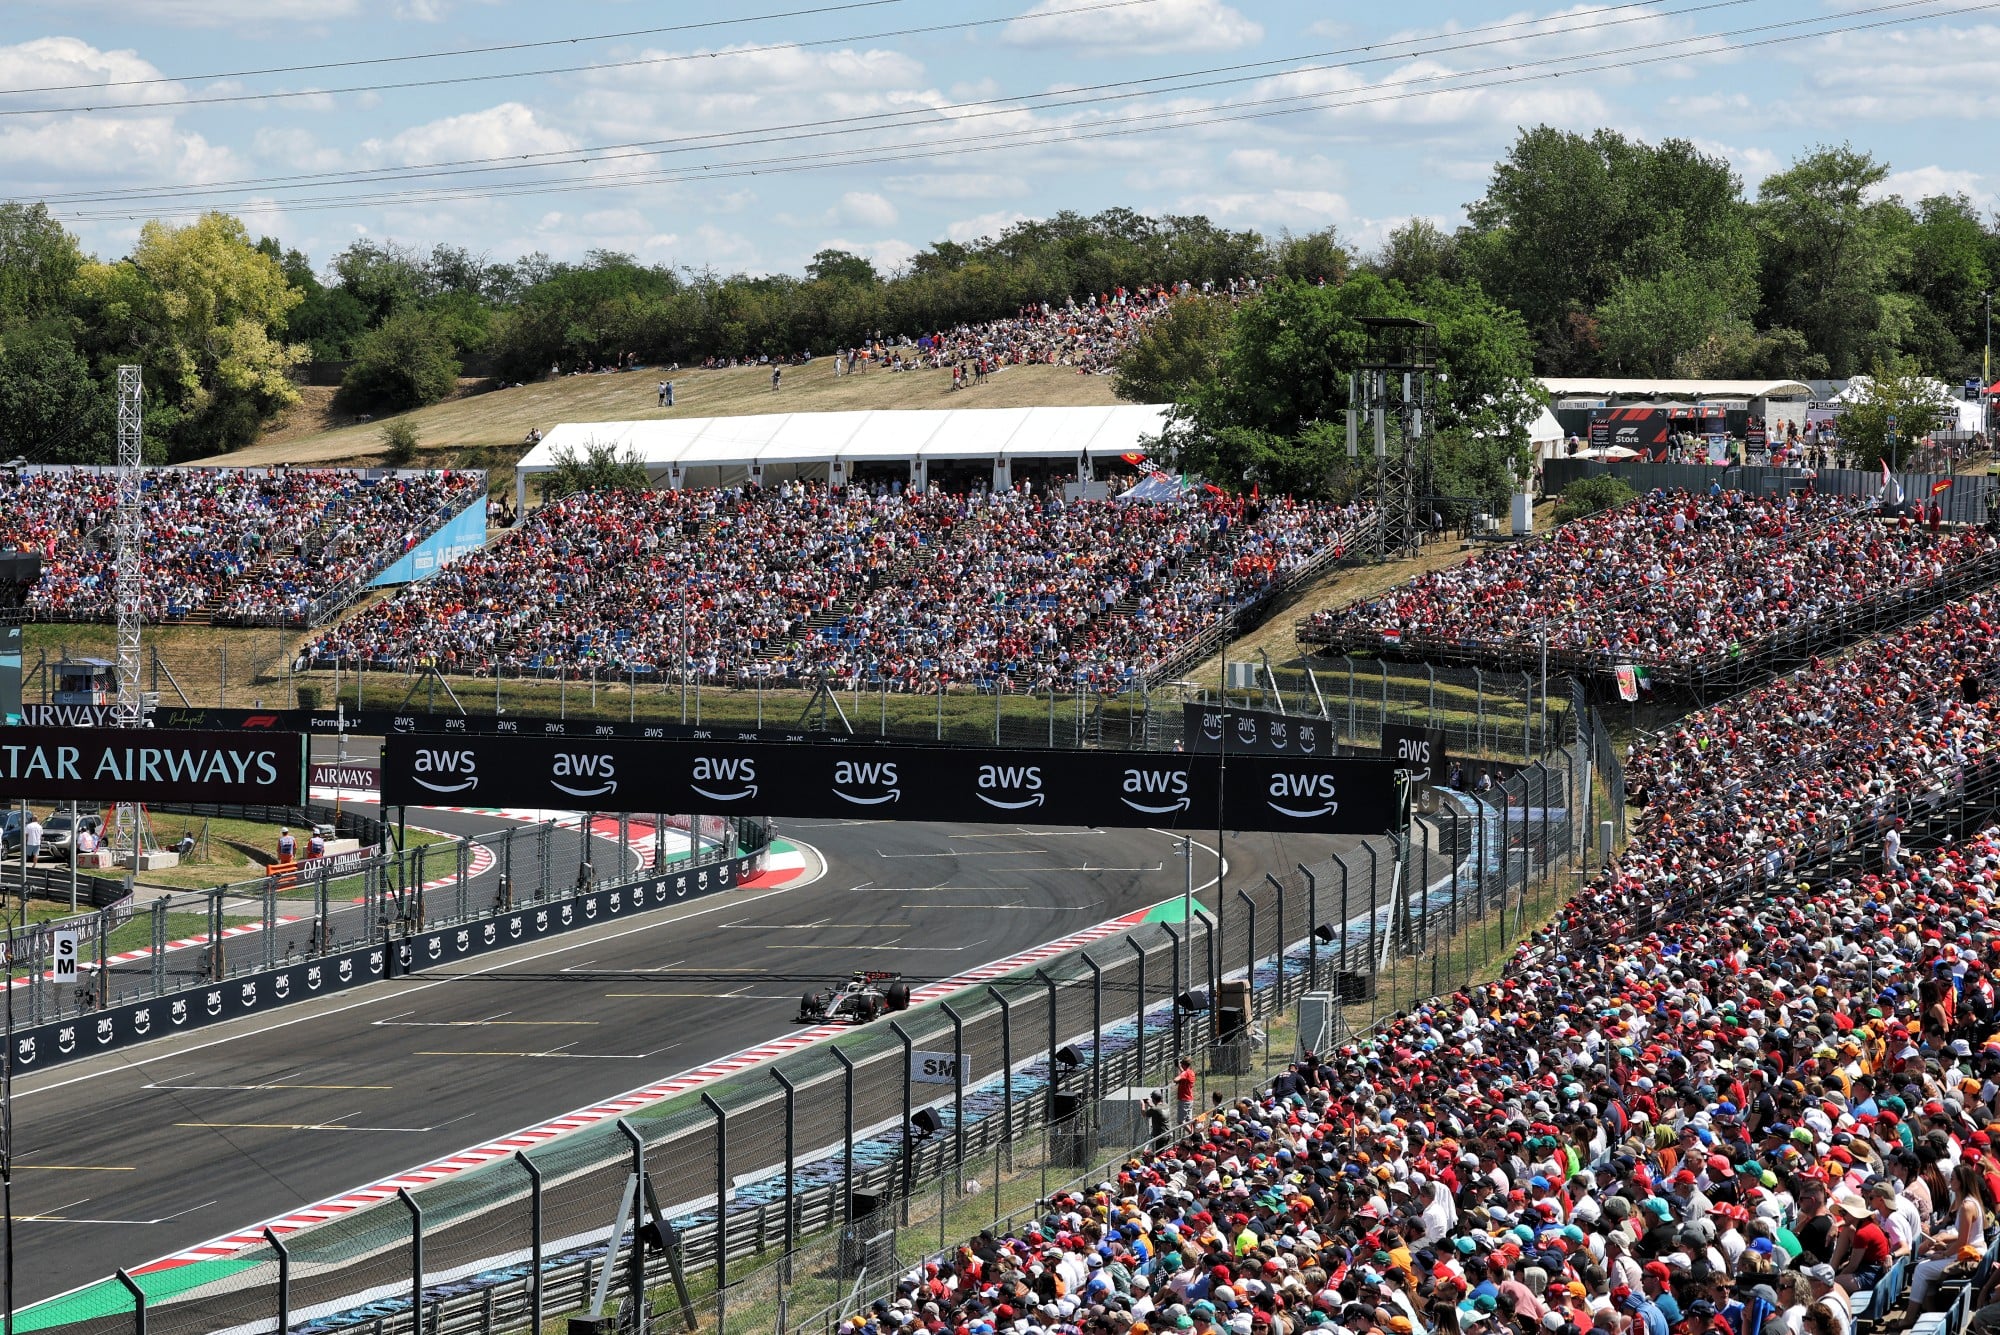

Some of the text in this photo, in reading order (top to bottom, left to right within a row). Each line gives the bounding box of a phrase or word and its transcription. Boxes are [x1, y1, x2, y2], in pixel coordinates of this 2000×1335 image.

[1615, 435, 1640, 443] Store
[394, 716, 415, 726] aws
[445, 718, 465, 728] aws
[497, 720, 517, 730] aws
[545, 722, 565, 732] aws
[1203, 713, 1222, 730] aws
[1238, 716, 1256, 733] aws
[1270, 721, 1287, 738] aws
[595, 725, 614, 735] aws
[644, 727, 663, 738] aws
[693, 729, 711, 739] aws
[1299, 725, 1314, 742] aws
[1398, 738, 1430, 763] aws
[0, 745, 277, 785] TAR AIRWAYS
[414, 749, 476, 773] aws
[553, 753, 615, 778] aws
[693, 757, 756, 782] aws
[314, 767, 373, 786] AIRWAYS
[834, 760, 898, 785] aws
[978, 765, 1042, 790] aws
[1122, 769, 1188, 794] aws
[1269, 772, 1336, 798] aws
[923, 1058, 957, 1077] SM
